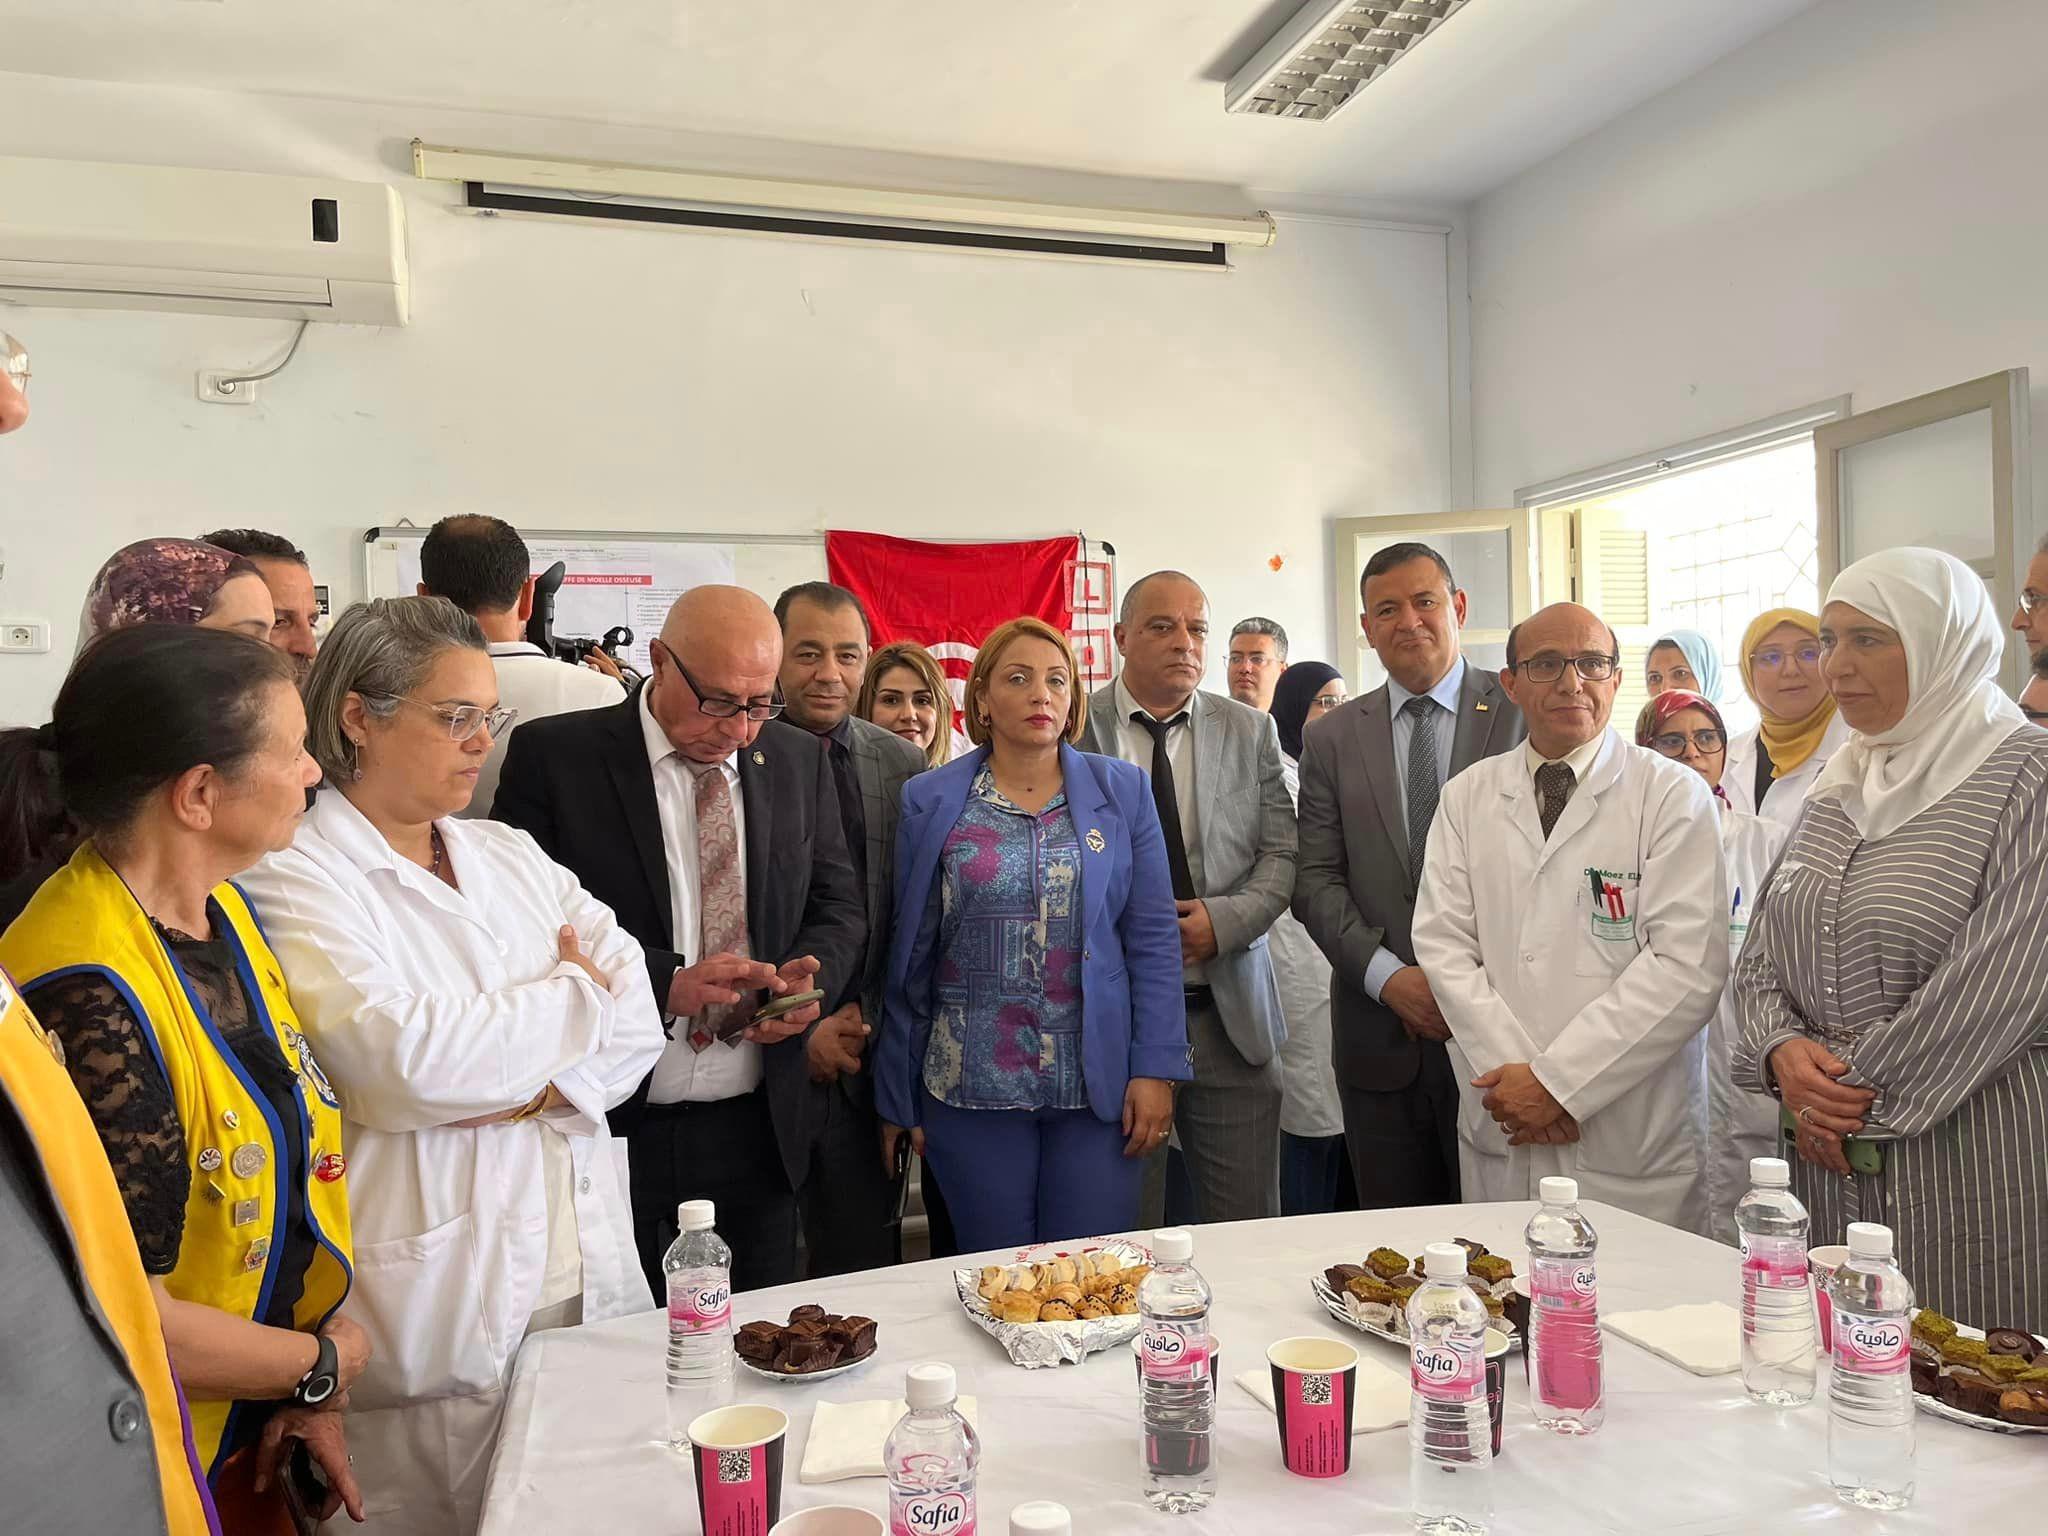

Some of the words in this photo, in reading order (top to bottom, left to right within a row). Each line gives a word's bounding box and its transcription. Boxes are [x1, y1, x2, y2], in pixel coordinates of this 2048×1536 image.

[1600, 870, 1623, 879] Moez
[699, 1287, 728, 1309] Safia
[1144, 1333, 1180, 1352] صافية
[1855, 1329, 1899, 1348] صافية
[1415, 1350, 1453, 1373] Safia
[911, 1503, 959, 1531] Safia
